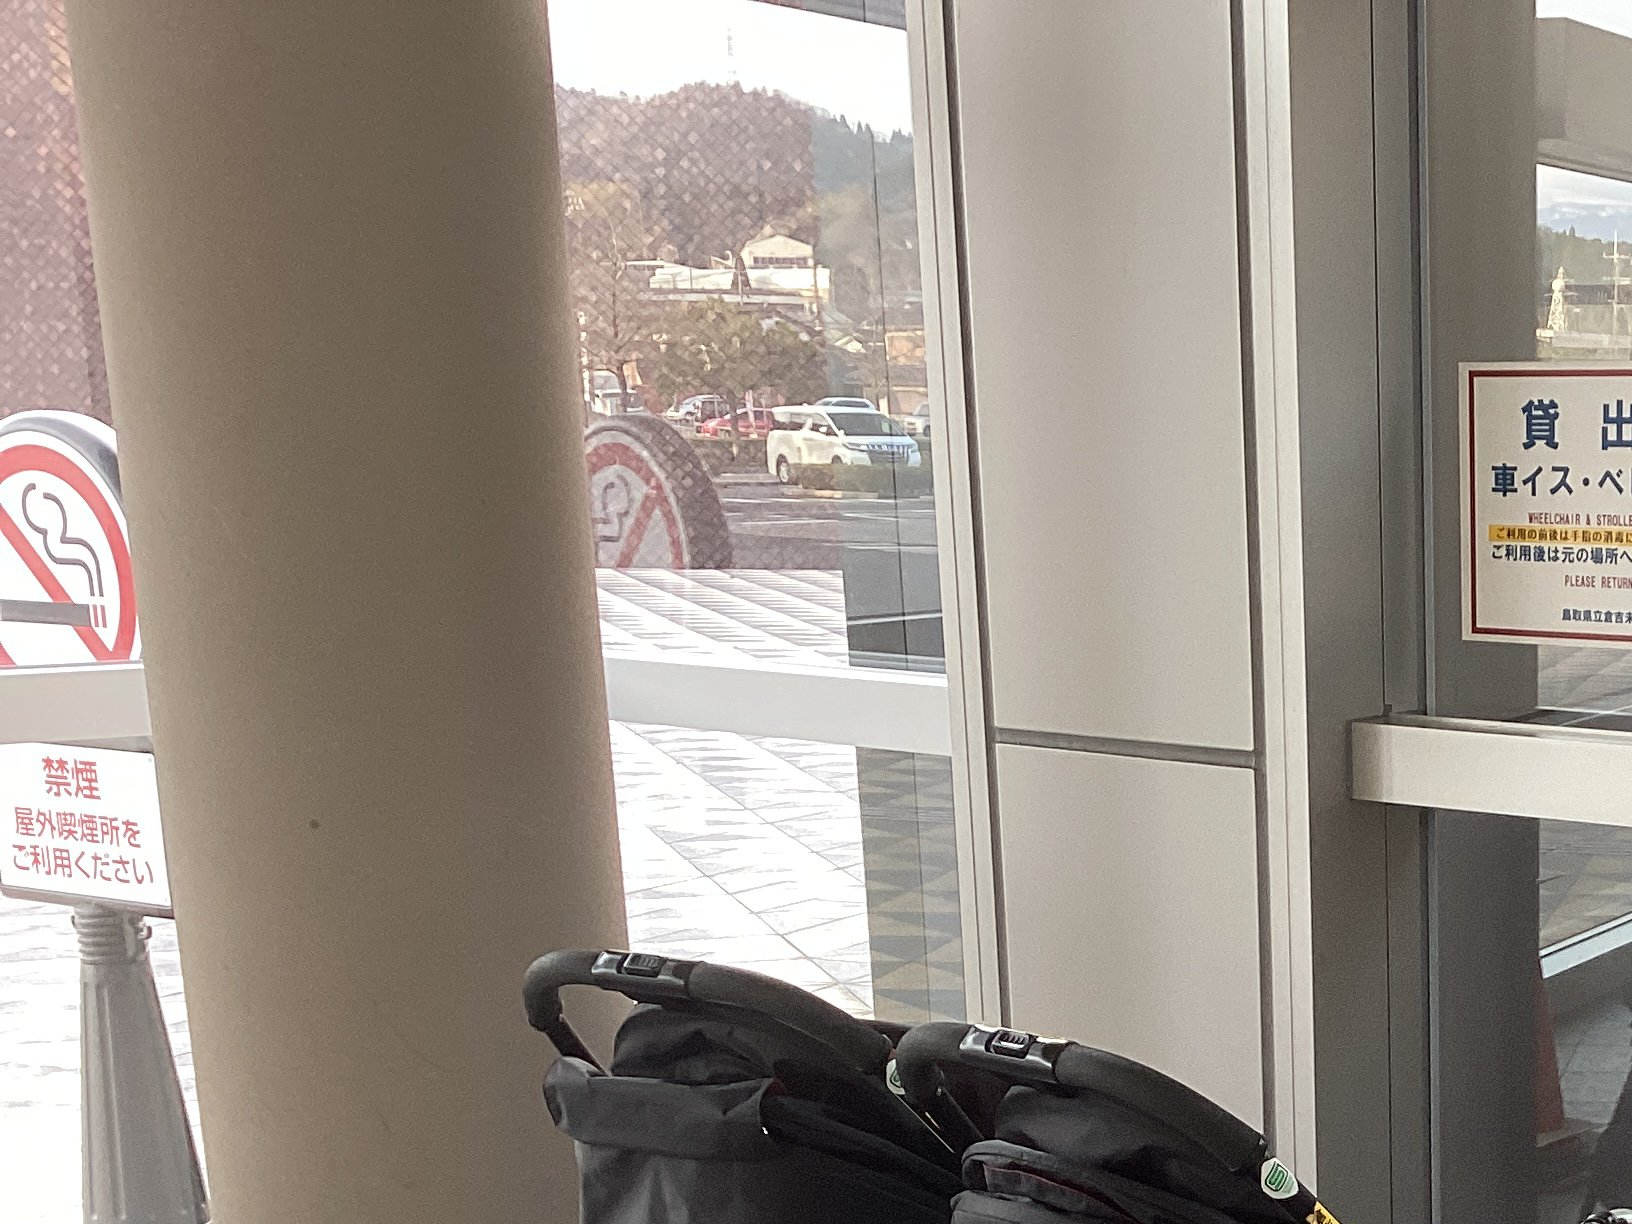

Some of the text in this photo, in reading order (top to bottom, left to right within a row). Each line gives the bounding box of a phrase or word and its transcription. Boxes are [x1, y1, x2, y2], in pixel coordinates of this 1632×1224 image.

[1528, 512, 1581, 526] WHEELCHAIR
[1586, 514, 1591, 526] &
[1564, 575, 1596, 588] PLEASE
[42, 756, 101, 800] 禁煙
[14, 806, 142, 848] 屋外喫煙所を
[12, 844, 154, 885] ご利用ください
